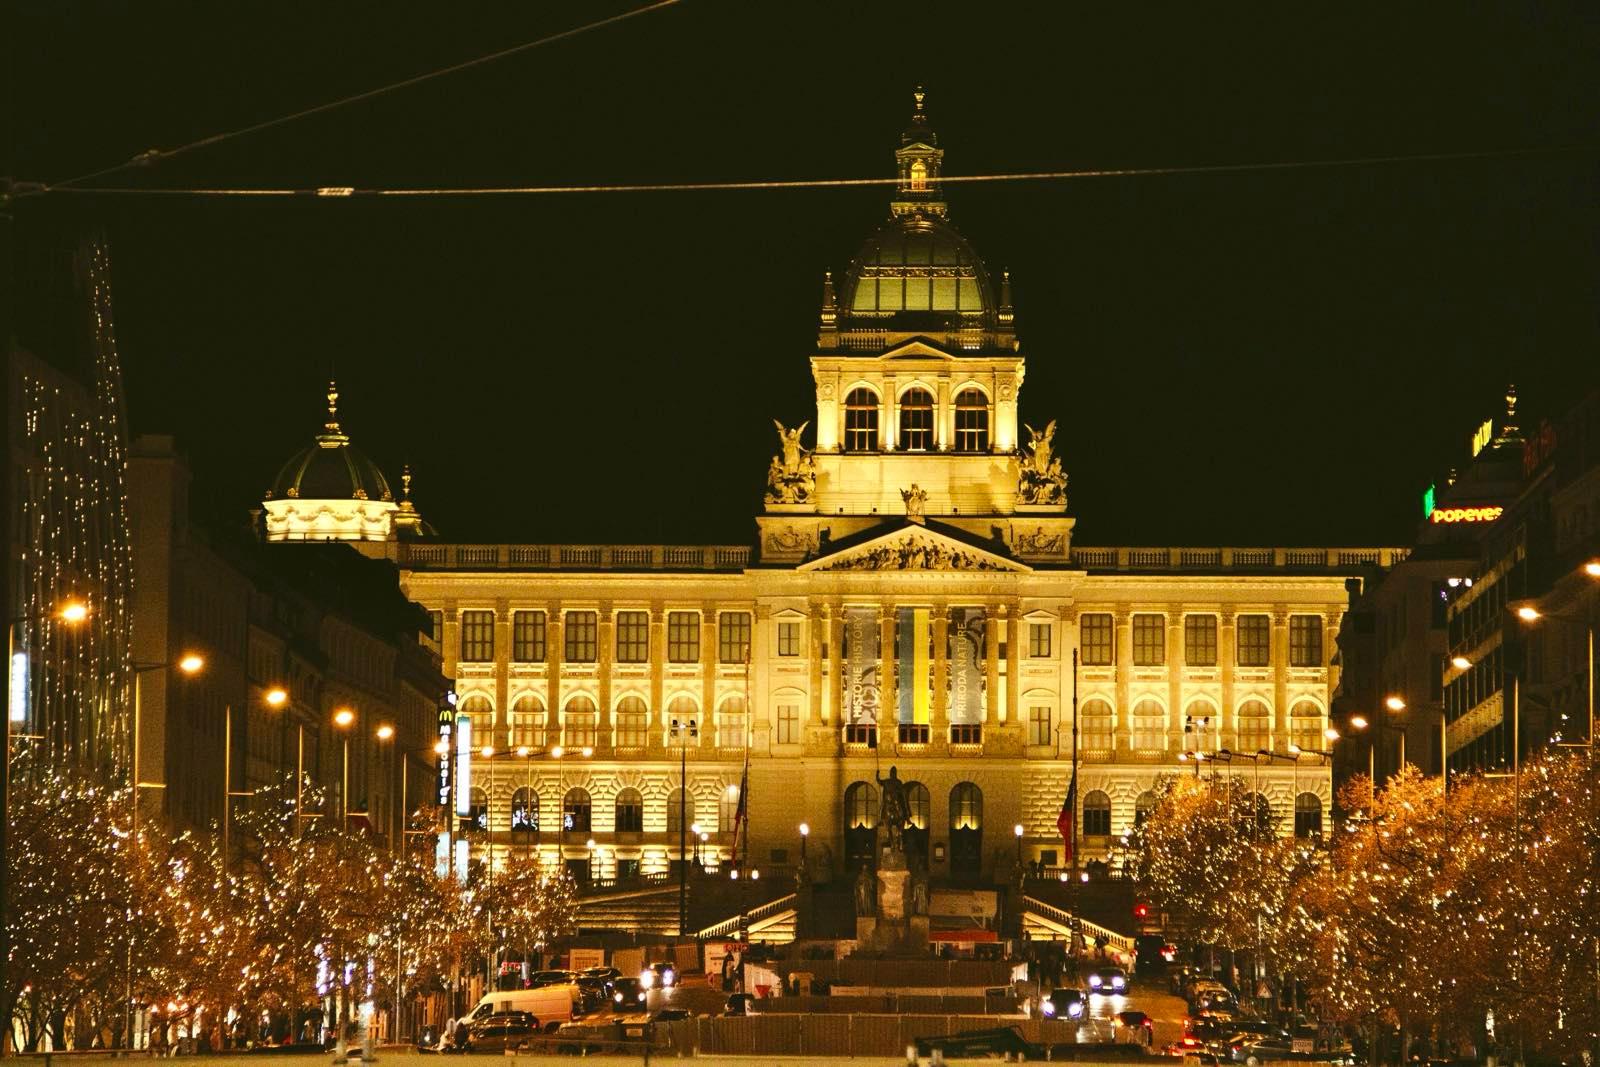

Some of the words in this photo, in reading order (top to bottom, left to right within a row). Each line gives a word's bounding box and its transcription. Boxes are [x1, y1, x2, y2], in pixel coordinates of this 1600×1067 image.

[1433, 507, 1504, 523] POPEYES
[852, 615, 863, 664] HISTORY
[957, 622, 967, 667] NATURE
[852, 666, 863, 718] HISTORIE
[440, 725, 451, 804] Mconald's
